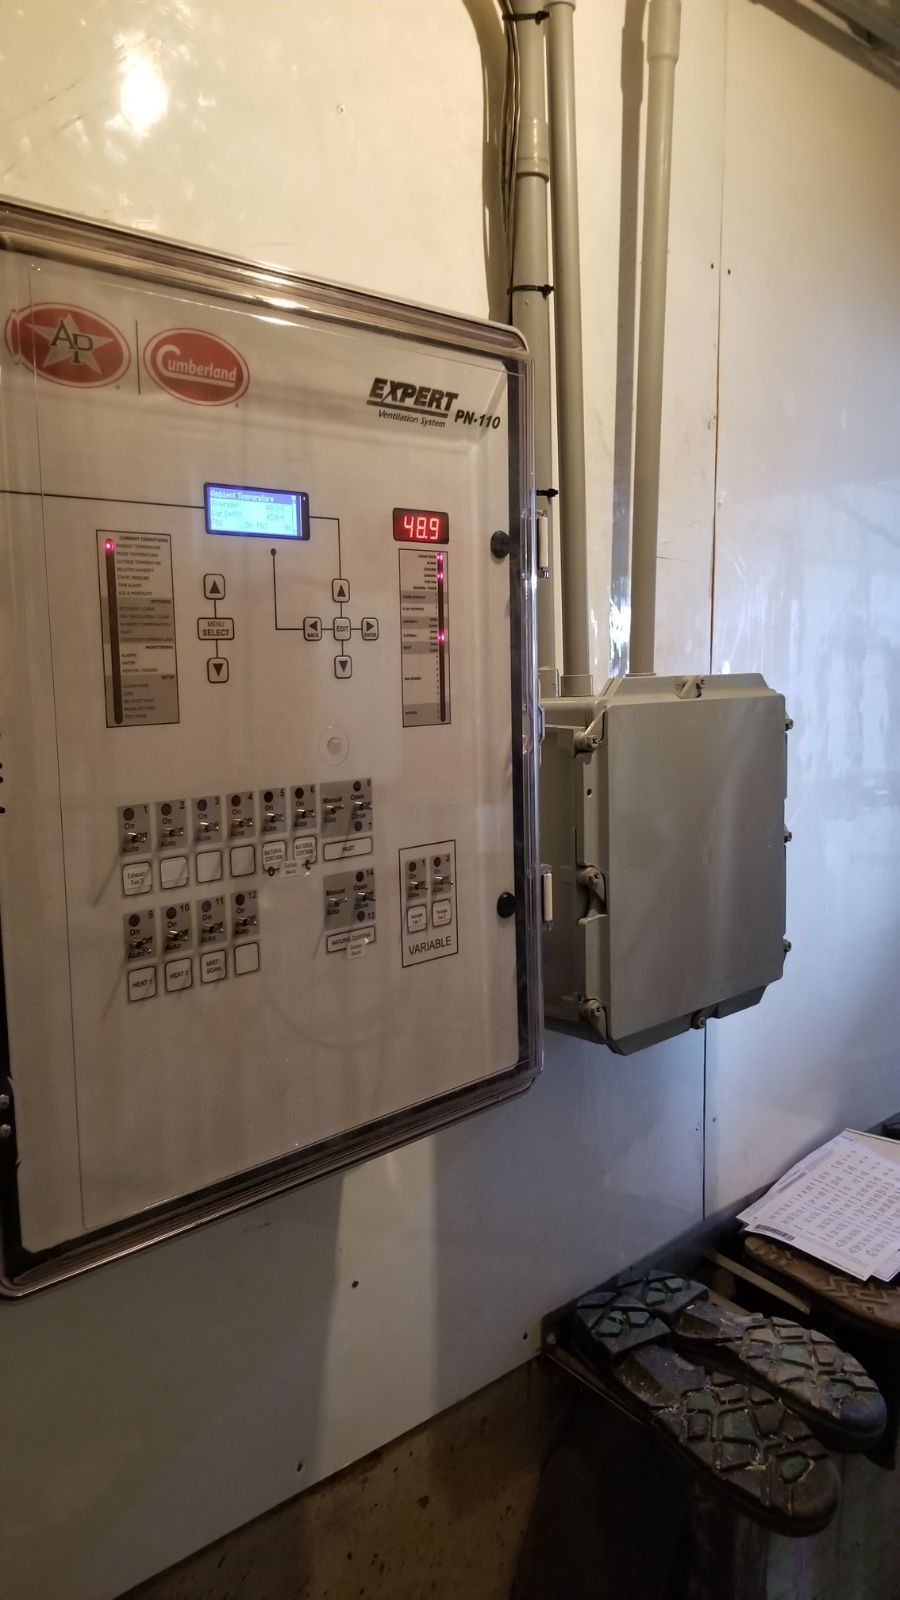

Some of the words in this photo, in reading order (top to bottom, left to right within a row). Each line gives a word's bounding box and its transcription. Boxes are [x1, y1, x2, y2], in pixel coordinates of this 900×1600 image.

[156, 344, 237, 387] Cumberland
[369, 377, 459, 412] EXPERT
[378, 410, 418, 424] Ventilation
[420, 417, 446, 428] System
[454, 409, 501, 430] PN-110
[403, 515, 440, 540] 48.9
[207, 620, 225, 628] MENU
[202, 629, 230, 637] SELECT
[336, 625, 349, 633] EDIT
[280, 788, 285, 797] 5
[310, 785, 315, 794] 6
[214, 796, 220, 805] 3
[248, 793, 253, 801] 4
[143, 805, 148, 814] 1
[179, 801, 185, 810] 2
[124, 822, 135, 830] On
[122, 846, 139, 854] Auto
[365, 869, 374, 877] 14
[247, 890, 257, 899] 12
[215, 897, 224, 905] 11
[179, 903, 190, 913] 10
[147, 910, 154, 919] 9
[166, 921, 177, 929] On
[234, 928, 250, 936] Auto
[200, 935, 216, 943] Auto
[164, 943, 182, 952] Auto
[408, 935, 452, 956] VARIABLE
[127, 951, 145, 960] Auto
[169, 971, 185, 980] HEAT
[132, 980, 148, 988] HEAT
